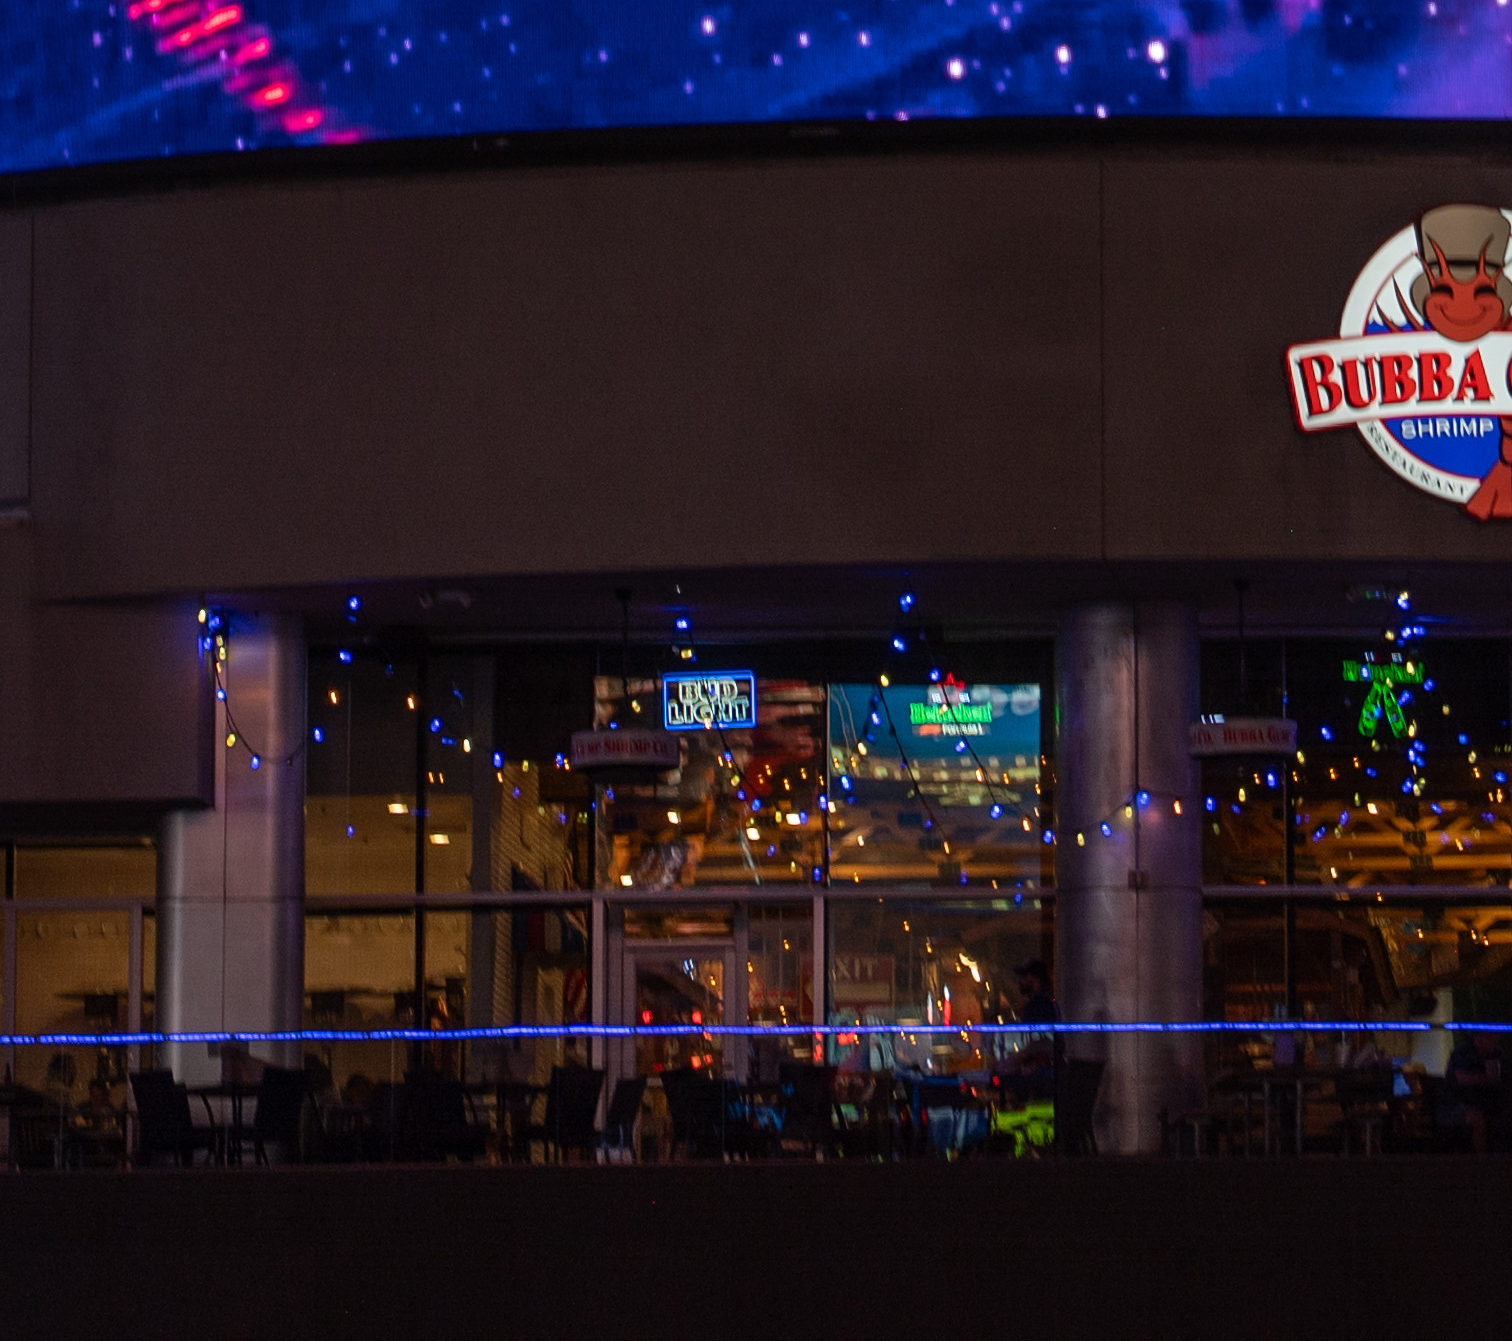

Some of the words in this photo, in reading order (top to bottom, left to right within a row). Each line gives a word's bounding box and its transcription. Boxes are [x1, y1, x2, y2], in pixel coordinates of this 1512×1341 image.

[1298, 347, 1495, 418] BUBBA
[1400, 418, 1494, 440] SHRIMP
[678, 677, 738, 705] BUD
[668, 696, 750, 725] LIGHT
[834, 955, 880, 982] XIT
